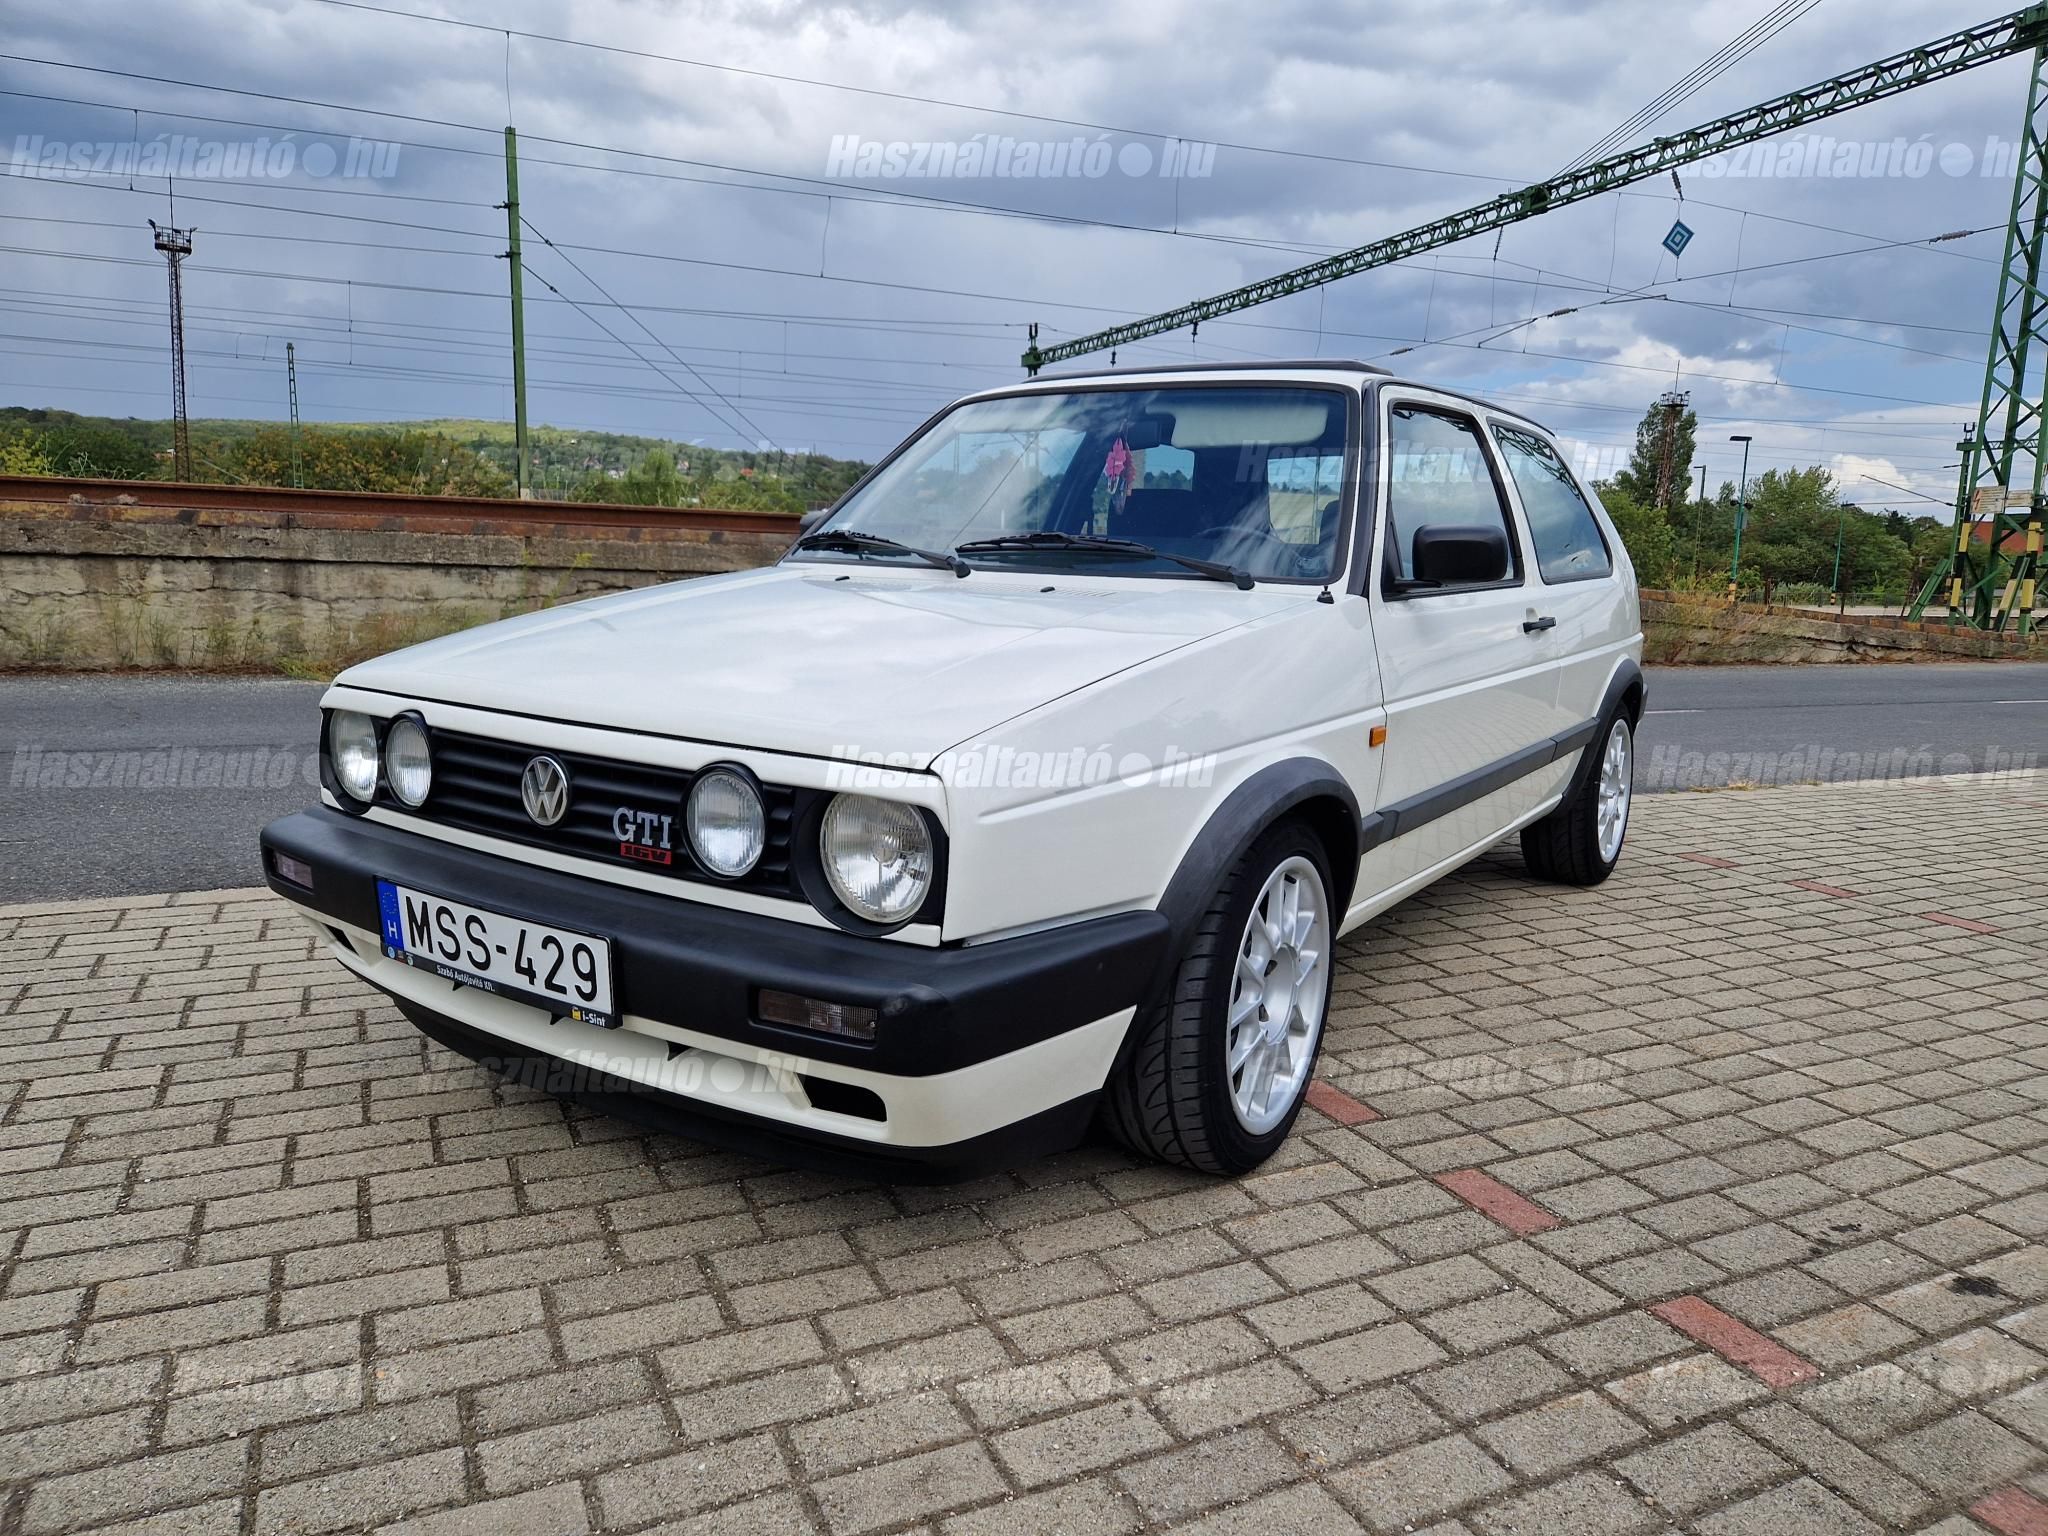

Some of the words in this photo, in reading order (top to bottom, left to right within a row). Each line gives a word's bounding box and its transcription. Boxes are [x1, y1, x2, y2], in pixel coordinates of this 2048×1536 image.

[613, 807, 673, 849] GTI
[622, 845, 668, 863] 16V
[387, 919, 399, 940] H
[405, 895, 598, 1002] MSS-429
[436, 964, 454, 979] Szabó
[582, 1010, 606, 1027] i-Sint
